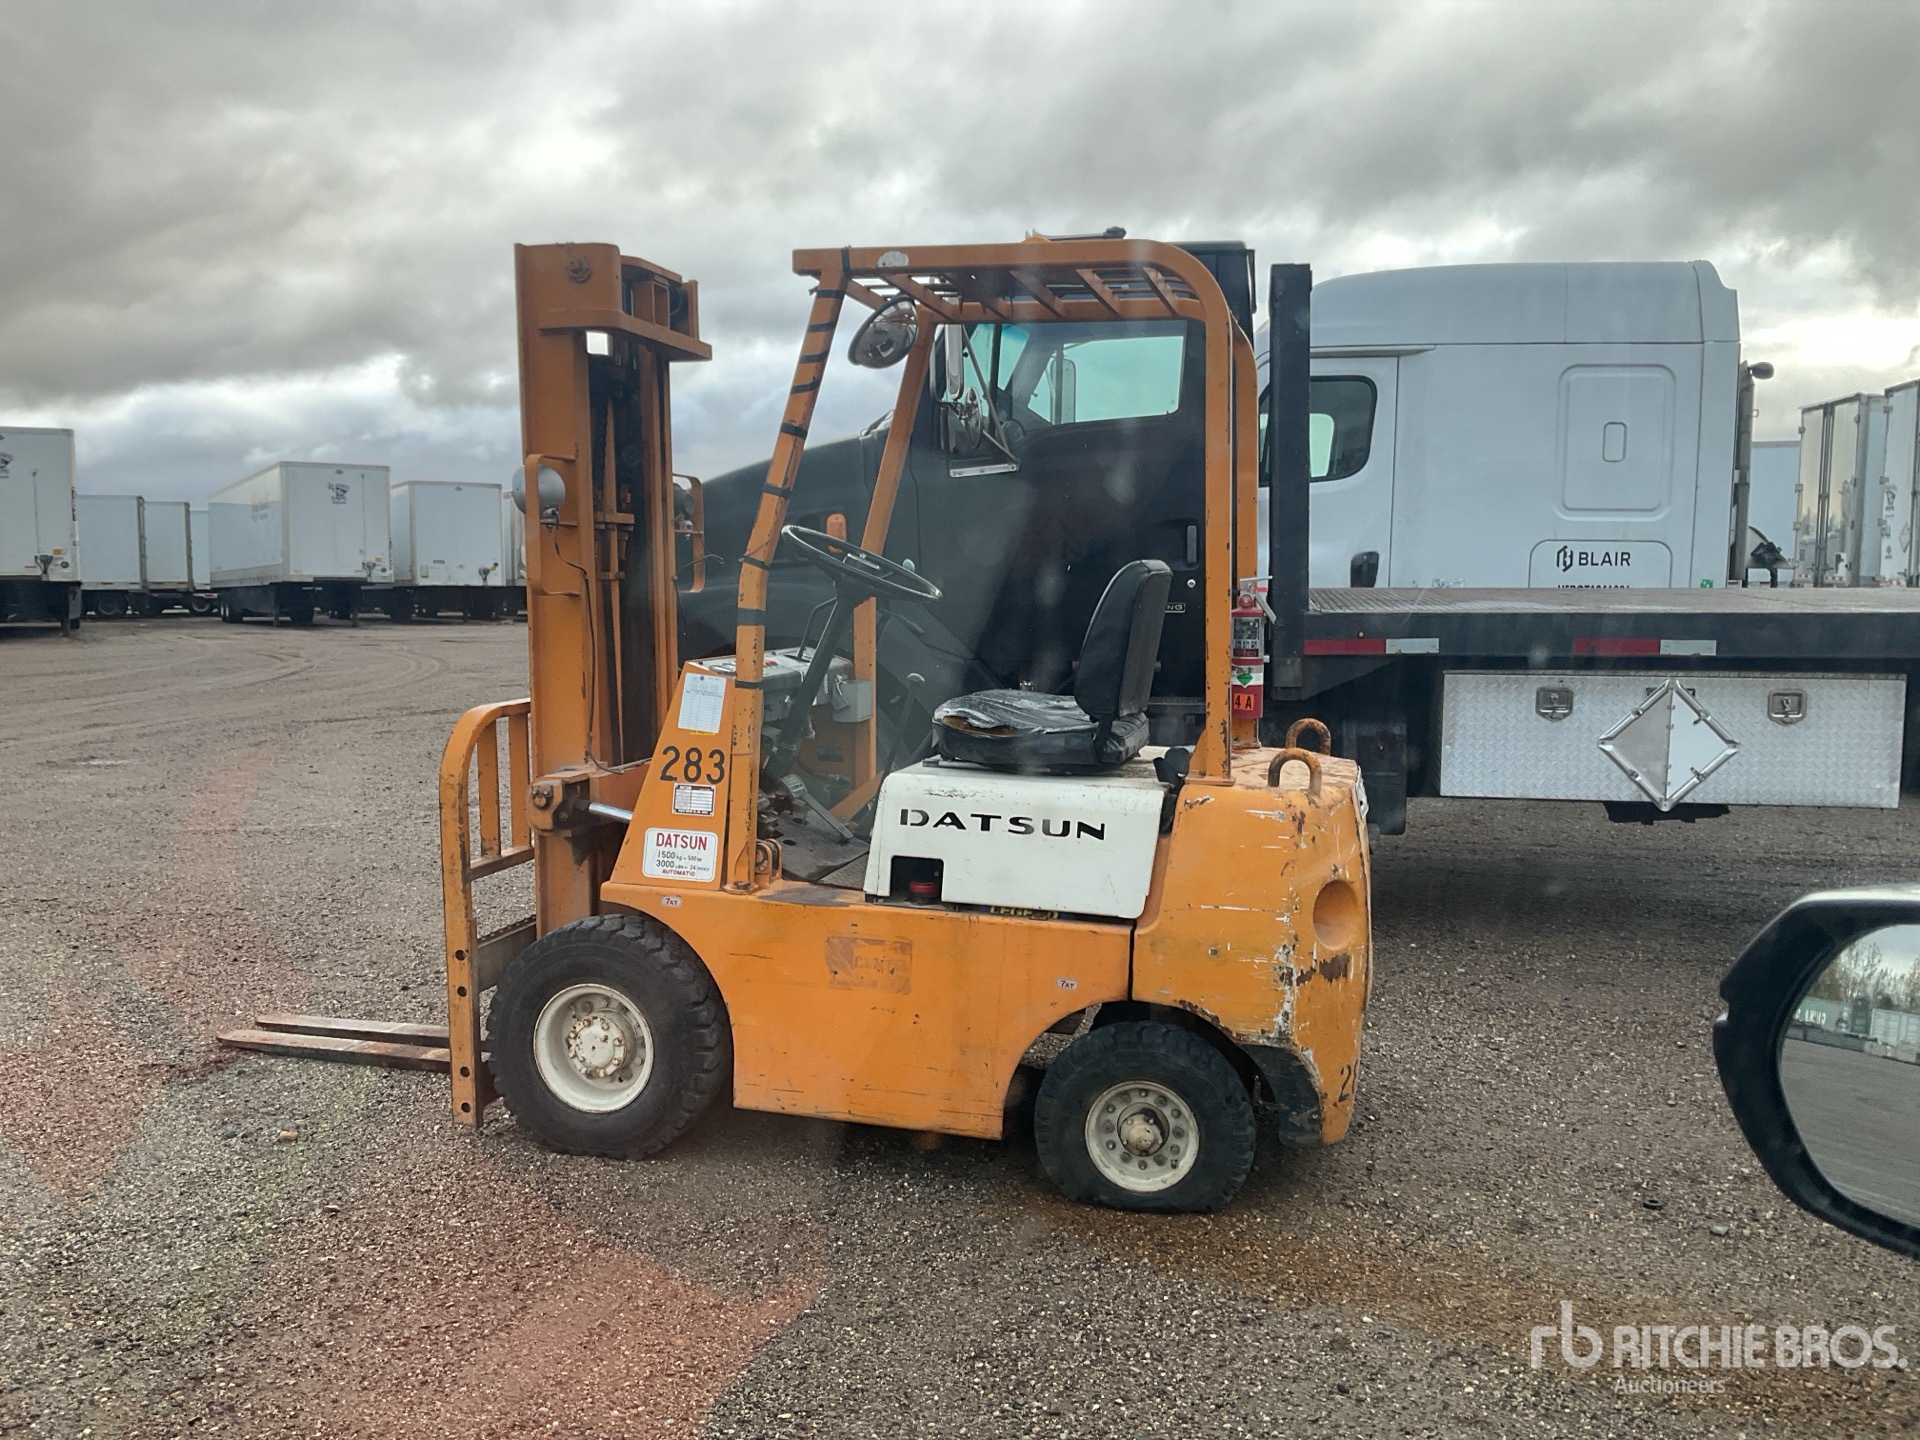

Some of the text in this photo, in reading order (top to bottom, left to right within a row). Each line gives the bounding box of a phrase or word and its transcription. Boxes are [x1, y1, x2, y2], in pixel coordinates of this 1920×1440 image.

[1578, 551, 1631, 566] BLAIR
[659, 745, 726, 784] 283
[900, 808, 1106, 841] DATSUN
[656, 832, 707, 851] DATSUN
[657, 850, 676, 860] 1500
[656, 860, 675, 868] 3000
[661, 869, 696, 877] AUTOMATIC
